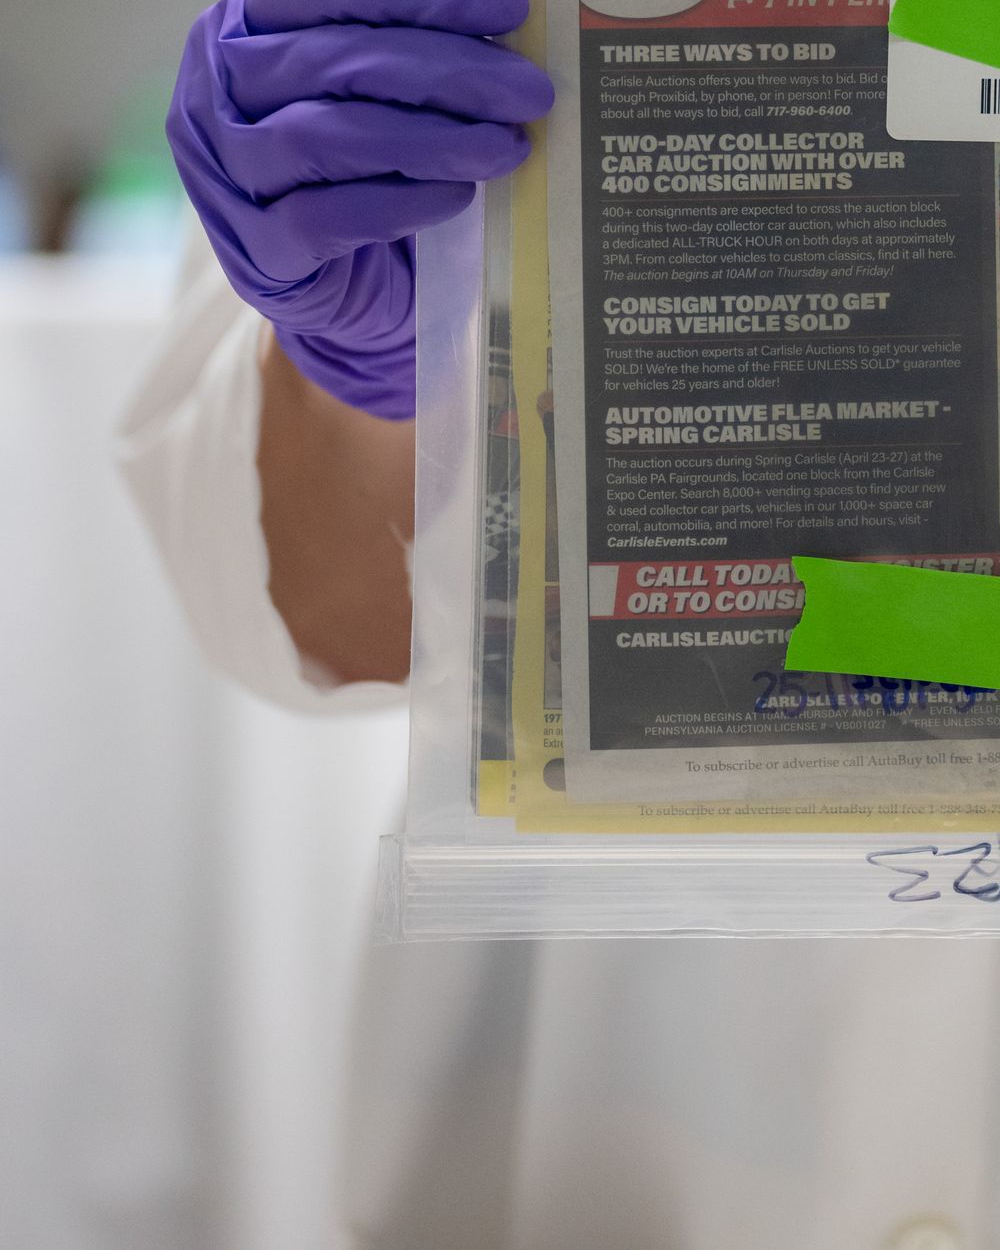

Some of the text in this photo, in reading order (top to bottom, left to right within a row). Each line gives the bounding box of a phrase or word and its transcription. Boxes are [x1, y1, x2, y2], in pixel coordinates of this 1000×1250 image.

[600, 43, 835, 62] THREE WAYS TO BID
[600, 73, 883, 88] Carlisle Auctions offers you three ways to bid. Bid
[600, 89, 885, 105] through Proxibid, by phone, or in person! For more
[600, 106, 851, 120] about all the ways to bid, call 717-960-6400.
[600, 133, 864, 153] TWO-DAY COLLECTOR
[601, 152, 904, 173] CAR AUCTION WITH OVER
[602, 173, 852, 193] 400 CONSIGNMENTS
[602, 202, 940, 220] 400+ consignments are expected to cross the auction block
[603, 293, 890, 314] CONSIGN TODAY TO GET
[603, 313, 851, 335] YOUR VEHICLE SOLD
[605, 404, 767, 424] AUTOMOTIVE
[771, 403, 832, 421] FLEA
[836, 401, 939, 420] MARKET
[605, 423, 820, 445] SPRING CARLISLE
[607, 535, 727, 547] CarlisleEvents.com
[636, 565, 709, 588] CALL
[627, 592, 668, 614] OR
[674, 591, 710, 613] TO
[685, 761, 701, 772] To
[703, 759, 762, 771] subscribe
[764, 761, 779, 770] or
[782, 757, 839, 769] advertise
[842, 756, 864, 768] call
[867, 755, 922, 770] AutaBuy
[925, 754, 946, 765] toll
[949, 753, 972, 765] free
